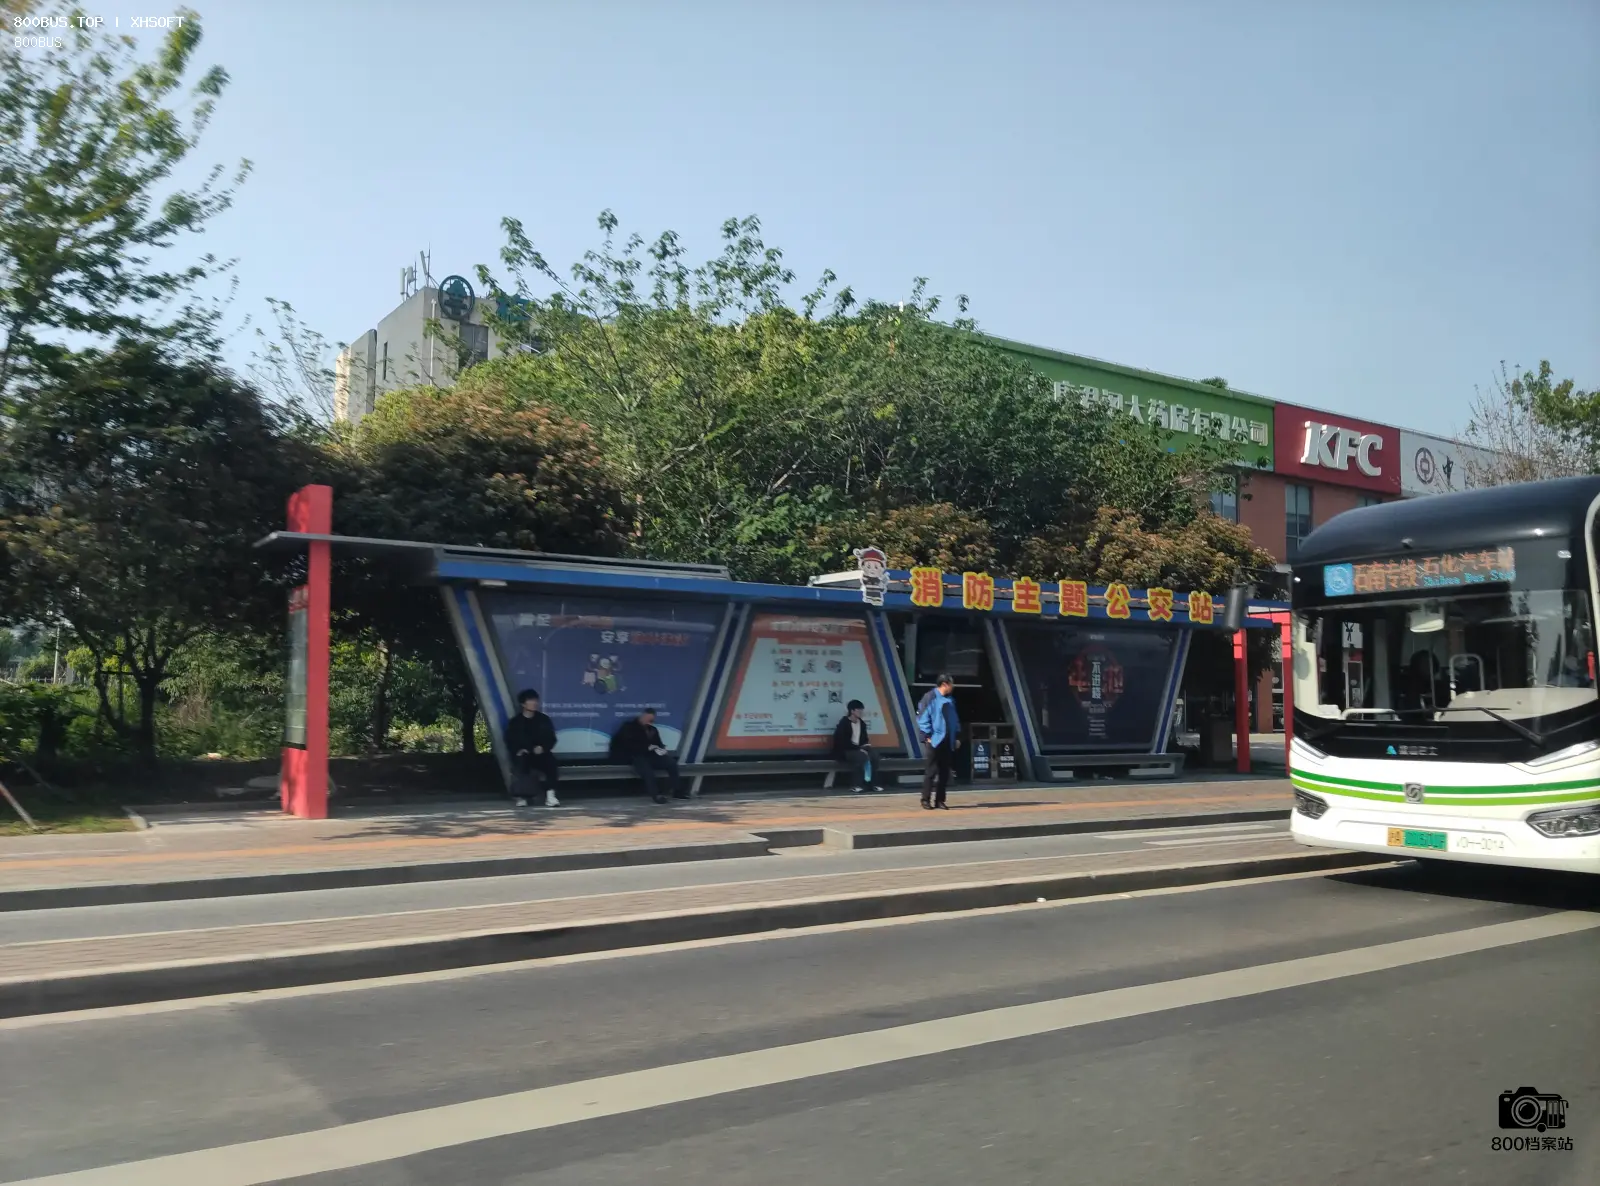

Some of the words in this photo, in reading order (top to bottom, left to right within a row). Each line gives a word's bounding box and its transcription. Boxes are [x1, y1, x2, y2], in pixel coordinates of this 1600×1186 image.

[1300, 420, 1384, 477] KFC
[910, 567, 1214, 625] 消防主题公交站
